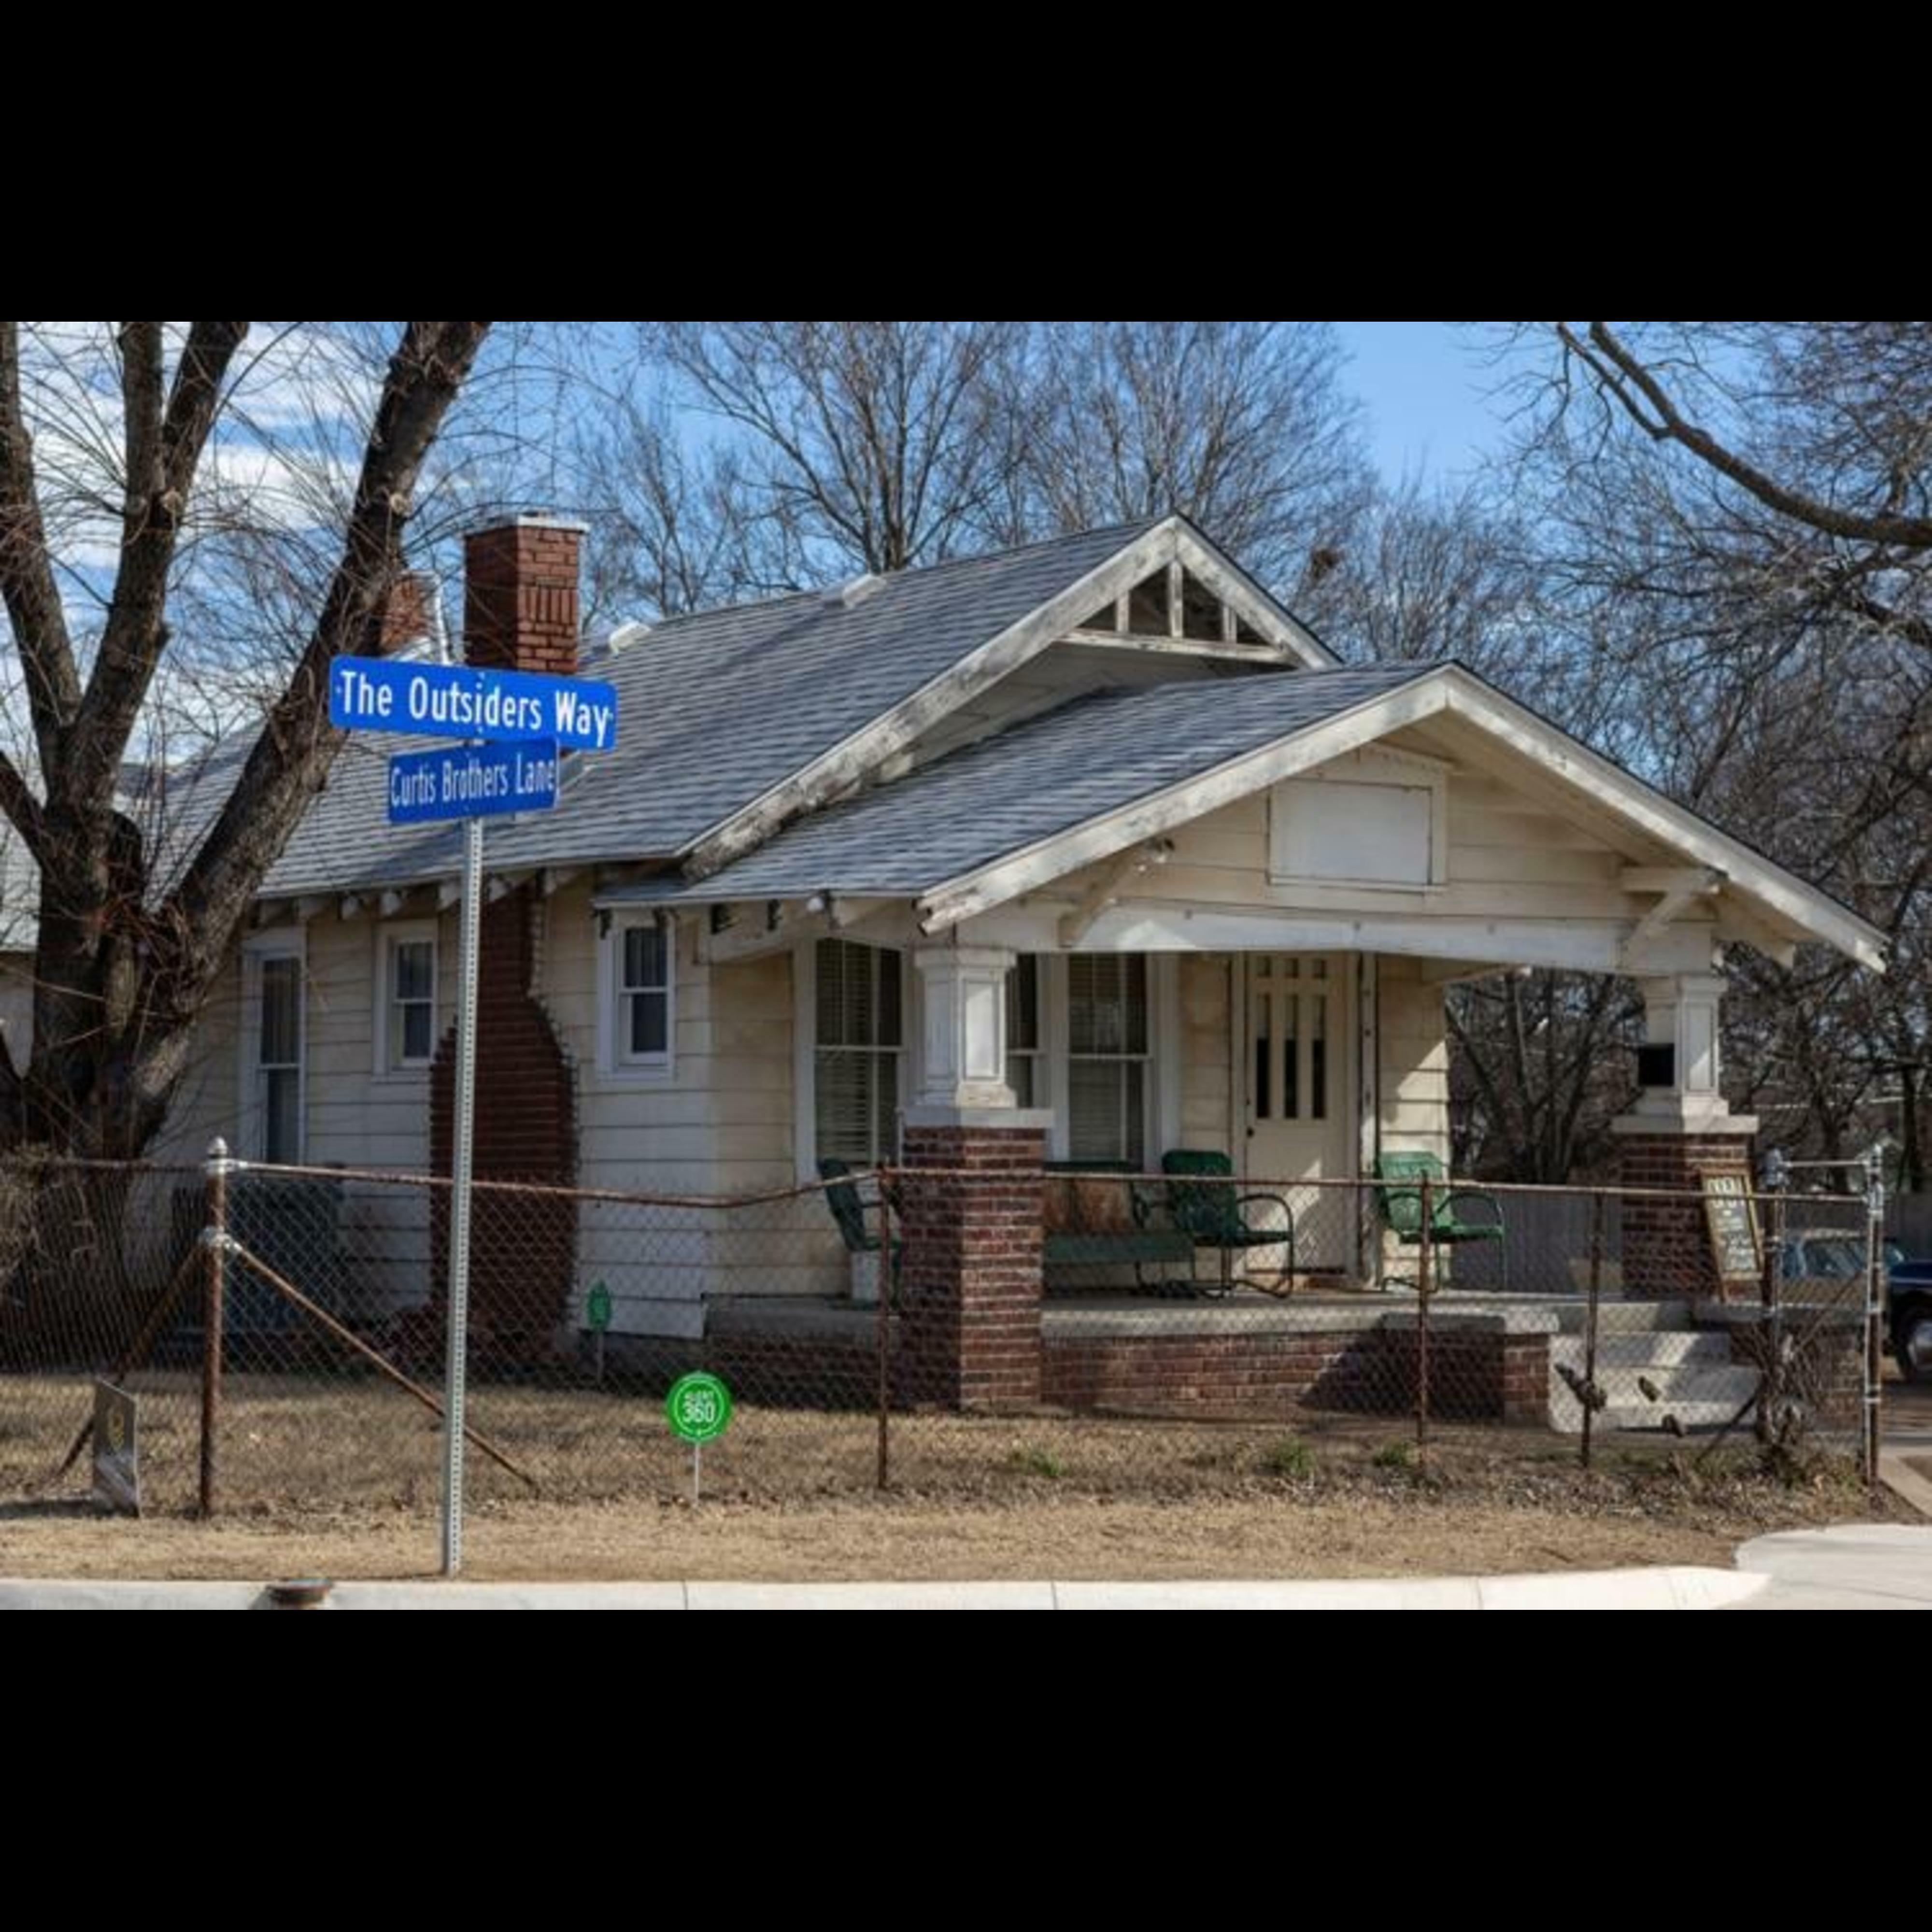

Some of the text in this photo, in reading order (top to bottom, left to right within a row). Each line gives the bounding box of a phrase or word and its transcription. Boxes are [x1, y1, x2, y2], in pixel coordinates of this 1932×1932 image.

[340, 670, 609, 747] The Outsiders Way
[391, 753, 555, 807] Curtis Brothers Lane
[683, 1401, 715, 1422] 360
